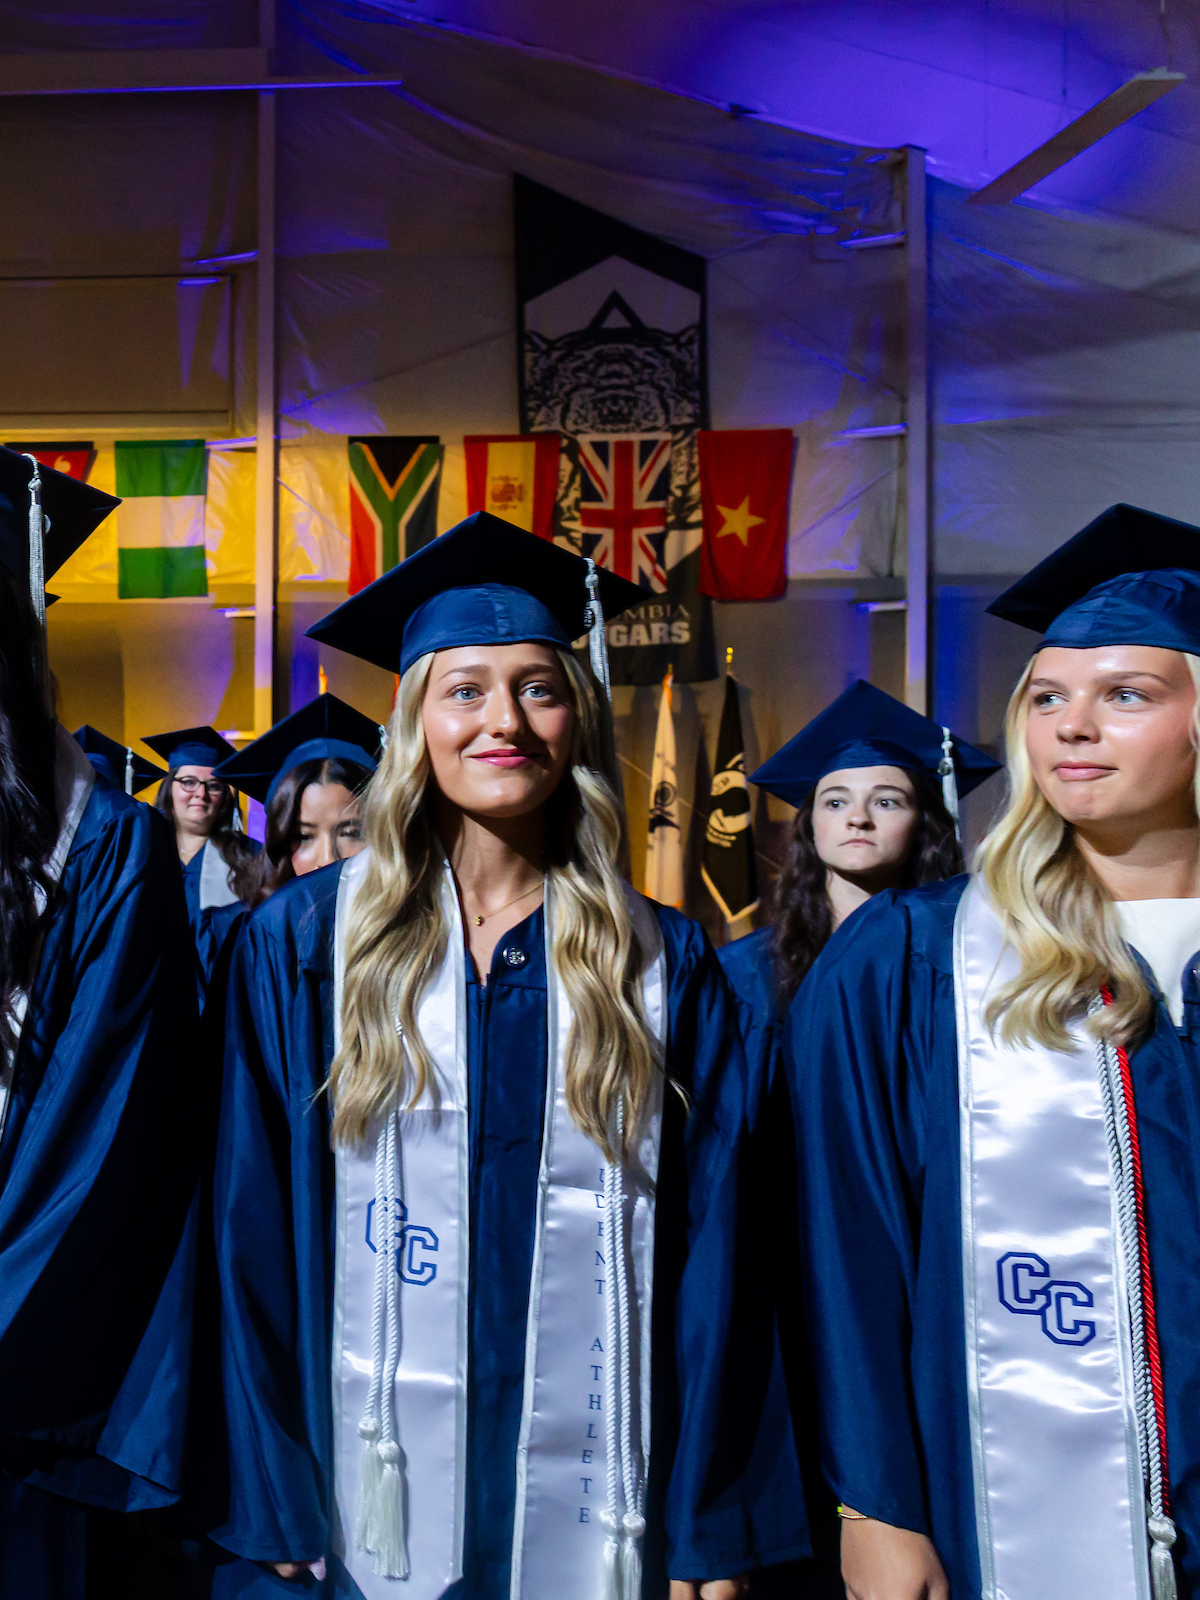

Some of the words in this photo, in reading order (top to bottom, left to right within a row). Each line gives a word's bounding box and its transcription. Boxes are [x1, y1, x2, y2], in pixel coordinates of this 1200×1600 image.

[622, 603, 690, 622] MBIA
[996, 1251, 1096, 1347] CC
[578, 1336, 605, 1523] ATHLETE
